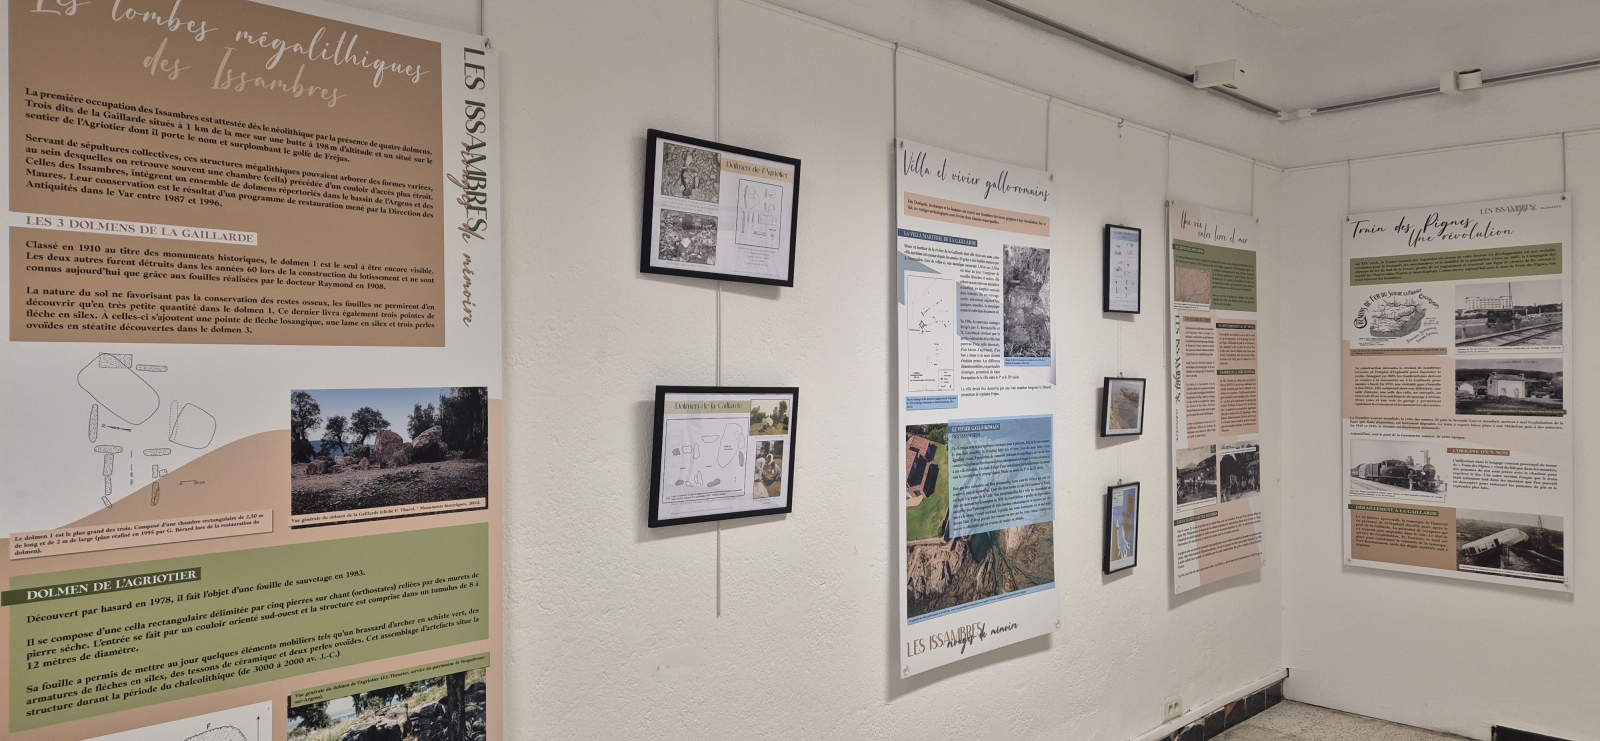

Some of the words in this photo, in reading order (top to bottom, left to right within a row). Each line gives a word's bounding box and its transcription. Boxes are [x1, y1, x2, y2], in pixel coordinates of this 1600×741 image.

[143, 37, 192, 80] des
[211, 46, 347, 108] Issambres
[236, 27, 430, 88] mégalithiques
[464, 47, 486, 90] LES
[26, 87, 37, 96] La
[40, 92, 83, 103] première
[85, 99, 136, 111] occupation
[138, 105, 153, 113] des
[155, 108, 198, 120] Issambres
[214, 118, 246, 128] attestée
[271, 126, 314, 138] néolithique
[337, 136, 368, 146] présence
[402, 145, 432, 154] dolmens.
[464, 100, 488, 232] ISSAMBRES
[904, 150, 931, 177] Villa
[952, 171, 980, 185] vivier
[26, 216, 51, 226] LES
[56, 218, 63, 227] 3
[69, 219, 135, 233] DOLMENS
[140, 225, 156, 234] DE
[162, 227, 177, 236] LA
[182, 229, 252, 242] GAILLARDE
[1351, 220, 1387, 238] Train
[1394, 216, 1414, 234] des
[1423, 212, 1474, 236] Pignes
[1408, 229, 1434, 248] Une
[1442, 221, 1514, 240] révolution
[462, 253, 476, 328] mémoire
[86, 528, 104, 536] grand
[177, 519, 200, 528] chambre
[202, 515, 236, 525] rectangulaire
[27, 584, 88, 600] DOLMEN
[93, 581, 111, 591] DE
[116, 570, 196, 588] L'AGRIOTIER
[27, 610, 78, 623] Découvert
[82, 608, 98, 617] par
[101, 601, 132, 612] hasard
[150, 596, 173, 605] 1978,
[203, 589, 228, 598] l'objet
[256, 581, 281, 590] fouille
[296, 575, 332, 584] sauvetage
[907, 638, 925, 657] LES
[930, 622, 982, 650] ISSAMBRES
